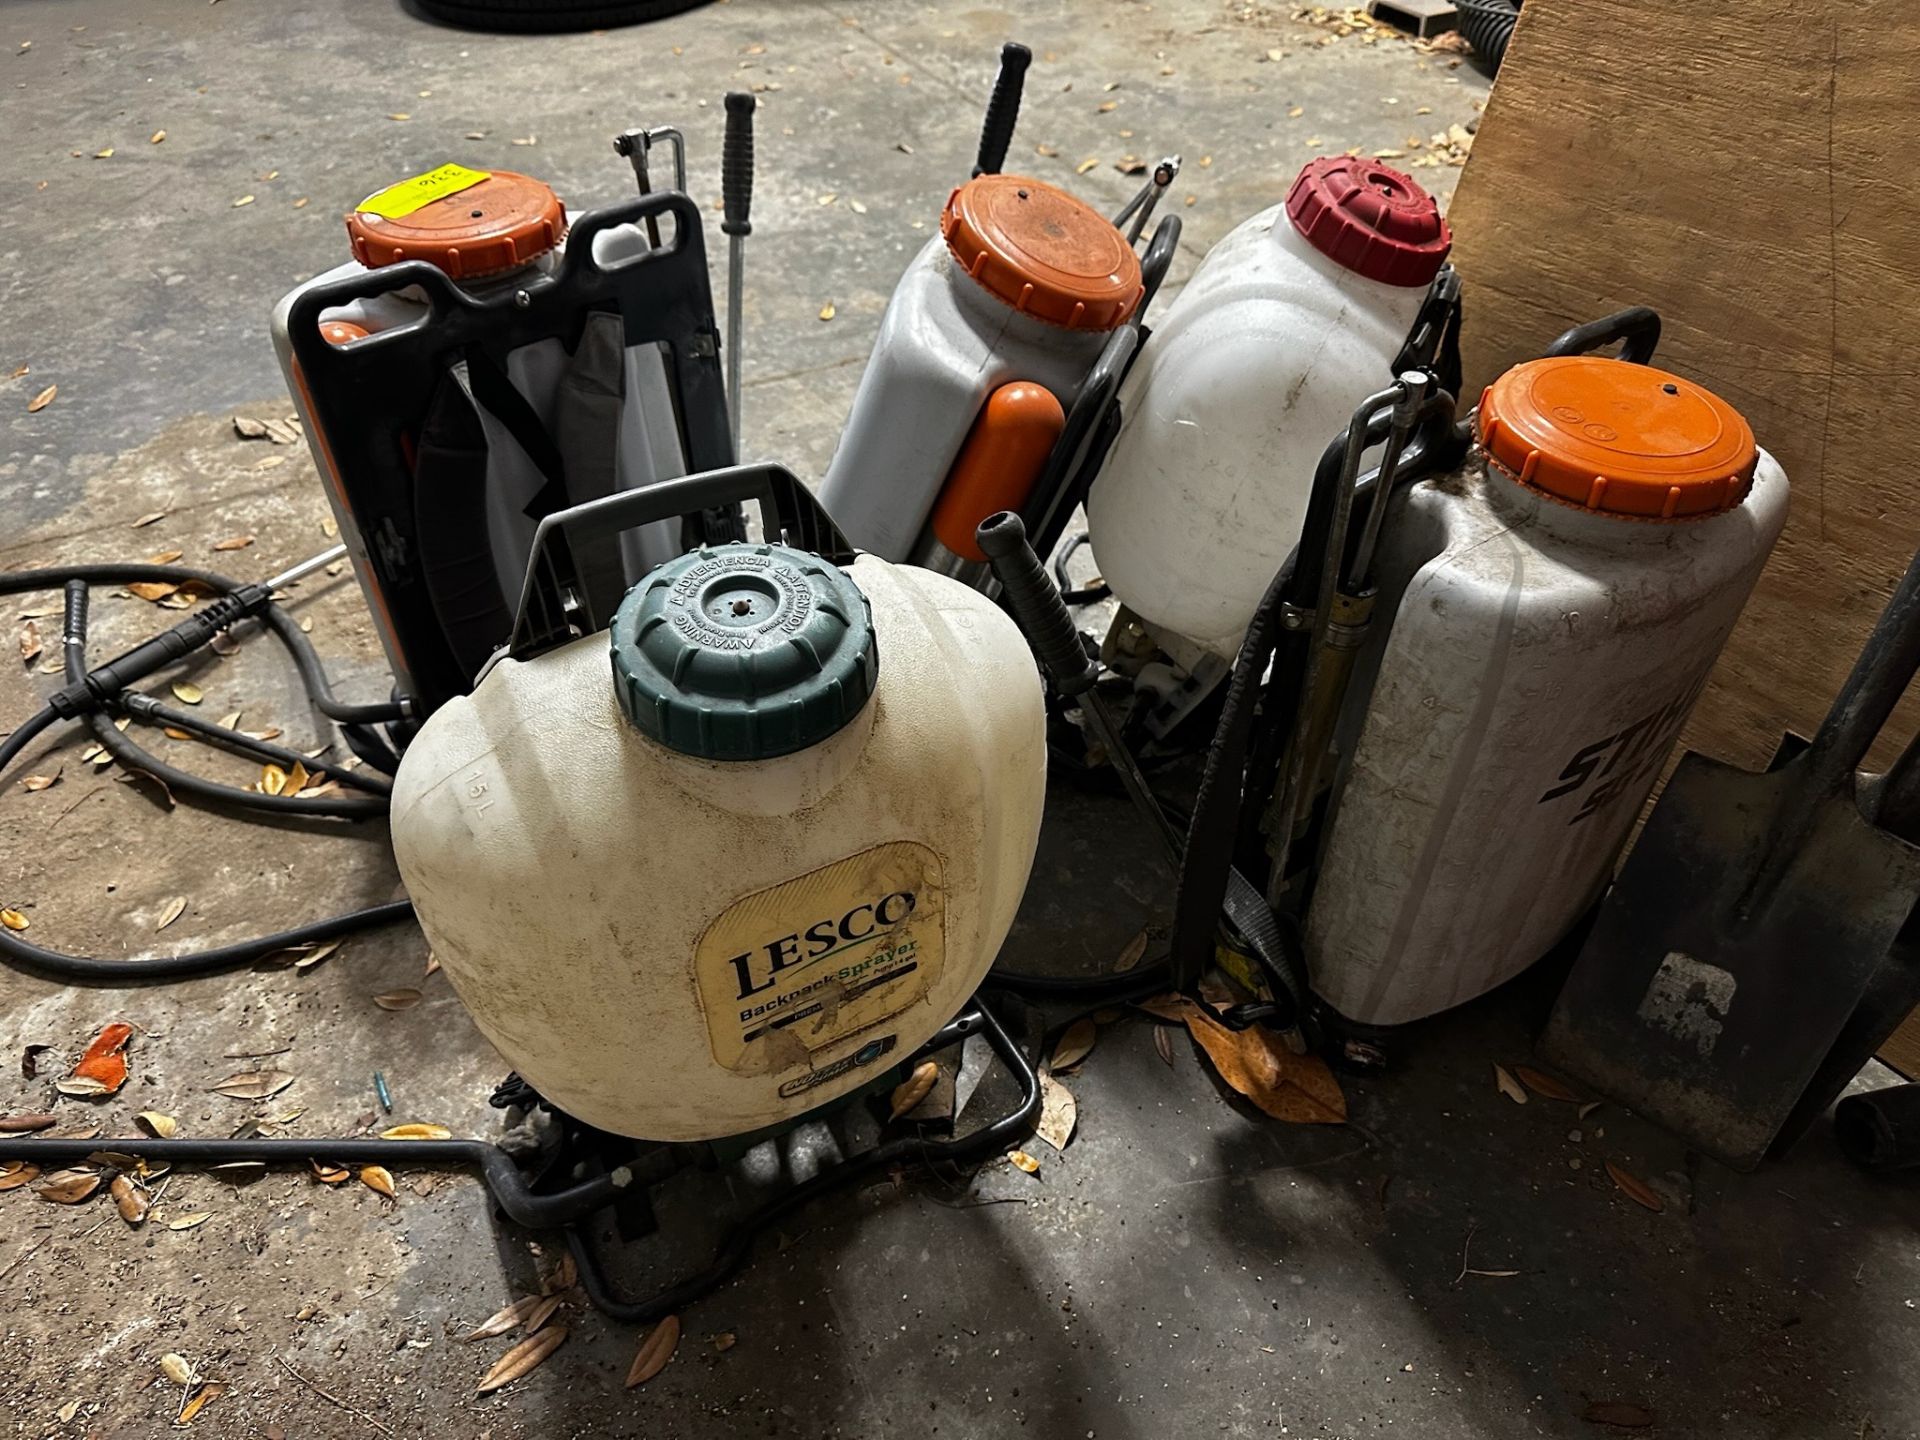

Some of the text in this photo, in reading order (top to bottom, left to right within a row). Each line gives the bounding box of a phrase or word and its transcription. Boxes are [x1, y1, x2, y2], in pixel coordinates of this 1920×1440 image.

[675, 555, 771, 596] ADVERTENCIA
[781, 574, 811, 635] ATTENTION
[675, 615, 740, 650] WARNING
[729, 891, 916, 1001] LESCO
[740, 939, 918, 1022] Backpack Sprayer
